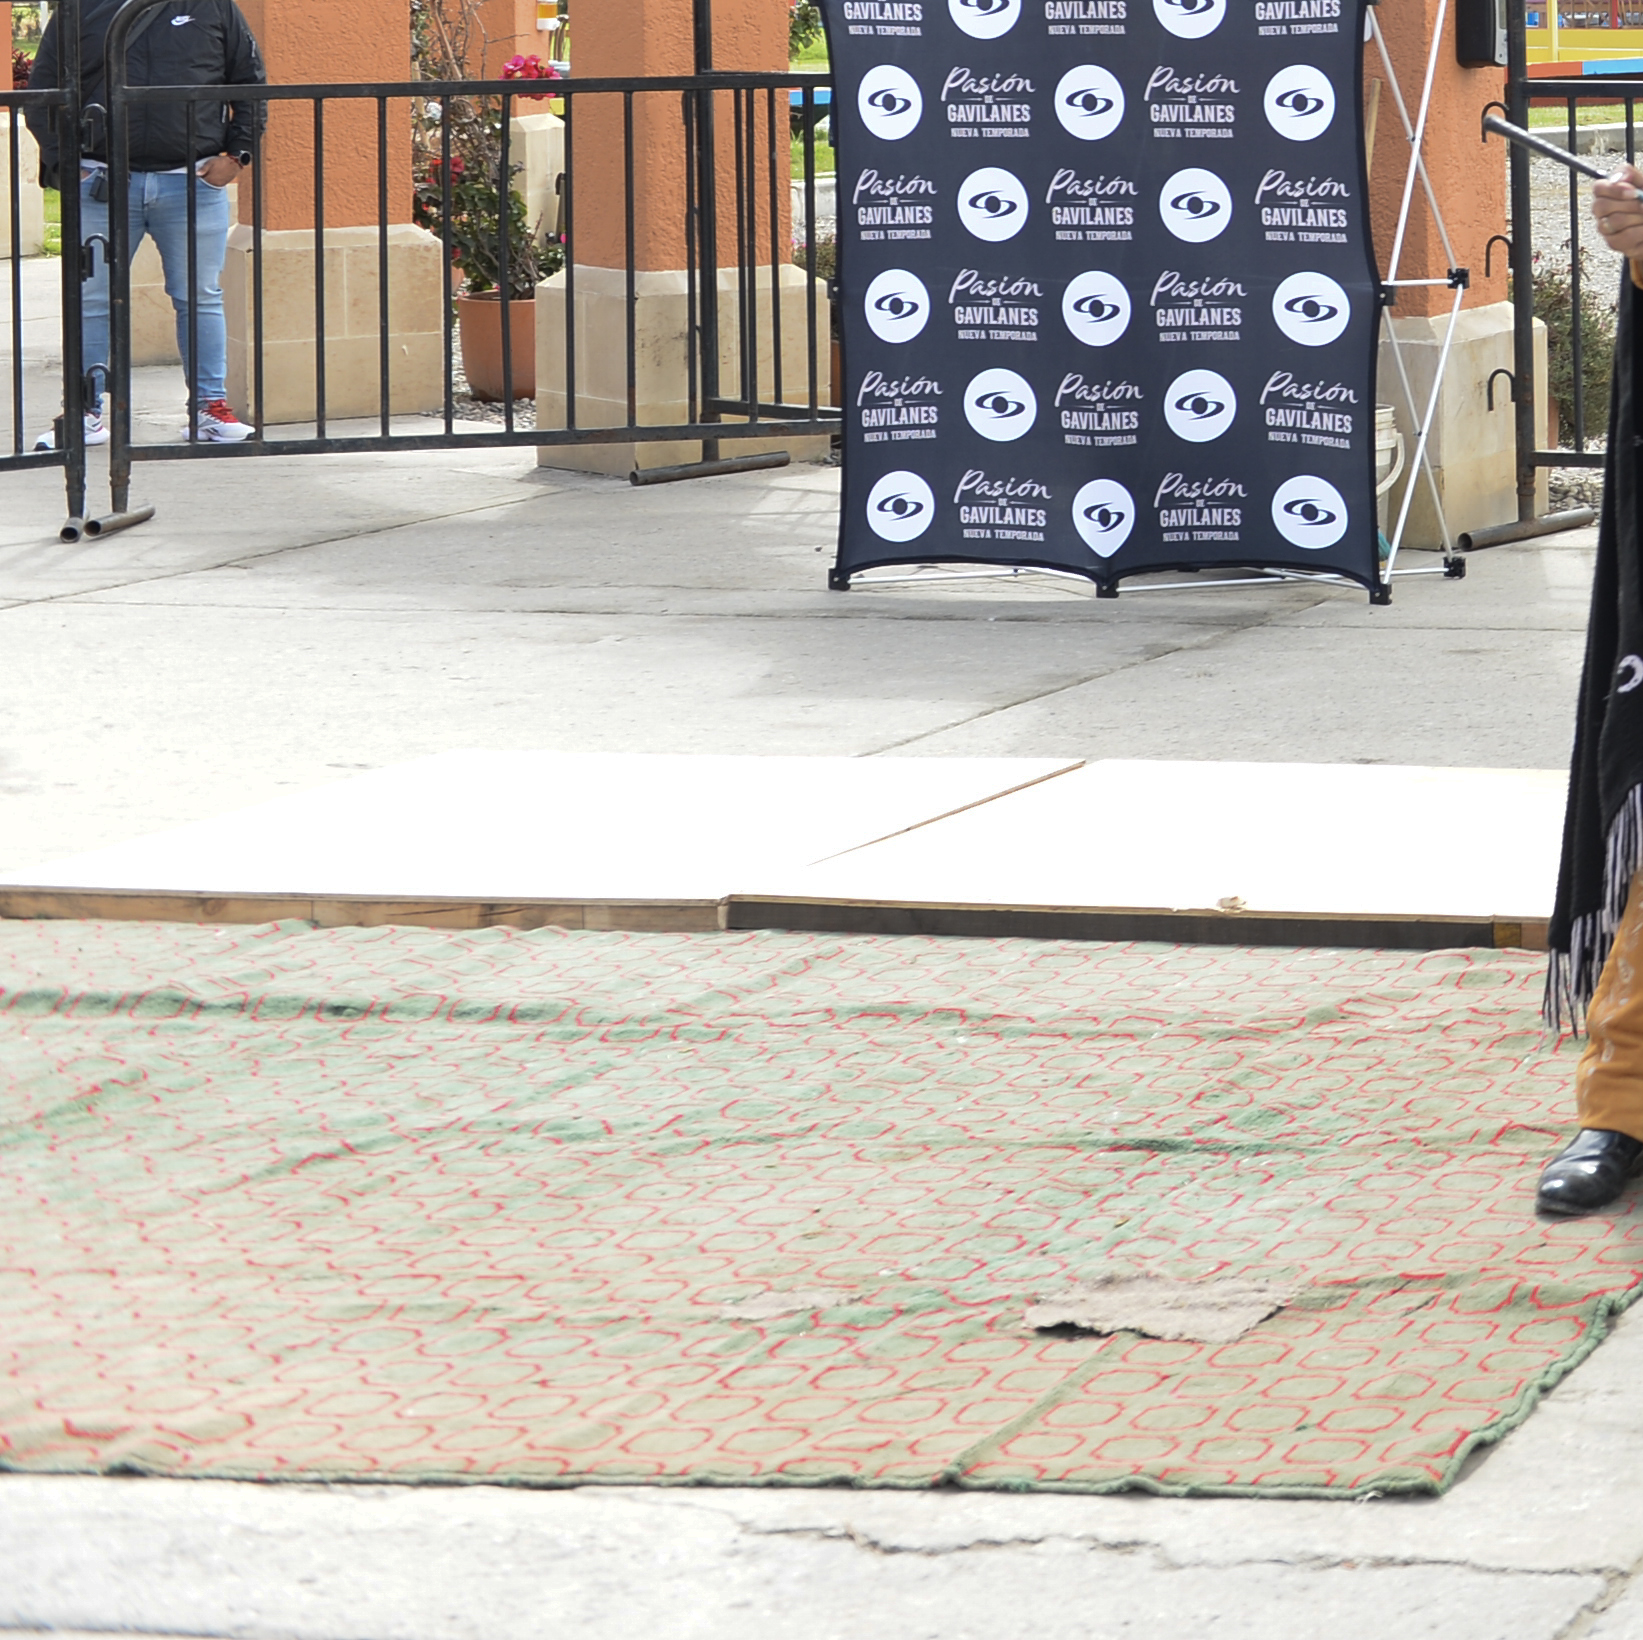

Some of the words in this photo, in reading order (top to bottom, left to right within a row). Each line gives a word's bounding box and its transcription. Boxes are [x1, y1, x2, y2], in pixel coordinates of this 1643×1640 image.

[843, 1, 923, 22] GAVILANES
[1044, 0, 1127, 20] GAVILANES
[1048, 24, 1077, 35] NUEVA
[1078, 24, 1126, 35] TEMPORADA
[940, 66, 1036, 102] Pasión
[1143, 65, 1240, 102] Pasión
[946, 104, 1031, 123] GAVILANES
[1150, 103, 1235, 123] GAVILANES
[950, 127, 980, 138] NUEVA
[981, 127, 1030, 138] TEMPORADA
[852, 168, 938, 205] Pasión
[1045, 168, 1138, 204] Pasión
[1254, 168, 1350, 205] Pasión
[857, 205, 933, 226] GAVILANES
[1051, 206, 1134, 226] GAVILANES
[1261, 206, 1348, 228] GAVILANES
[948, 268, 1044, 304] Pasión
[1150, 270, 1248, 307] Pasión
[954, 305, 1039, 327] GAVILANES
[1156, 307, 1242, 327] GAVILANES
[856, 370, 943, 407] Pasión
[1054, 372, 1144, 408] Pasión
[1259, 370, 1358, 405] Pasión
[861, 405, 938, 428] GAVILANES
[1060, 410, 1139, 431] GAVILANES
[1265, 407, 1353, 434] GAVILANES
[953, 469, 1052, 504] Pasión
[1153, 472, 1248, 509] Pasión
[959, 505, 1047, 527] GAVILANES
[1159, 508, 1242, 528] GAVILANES
